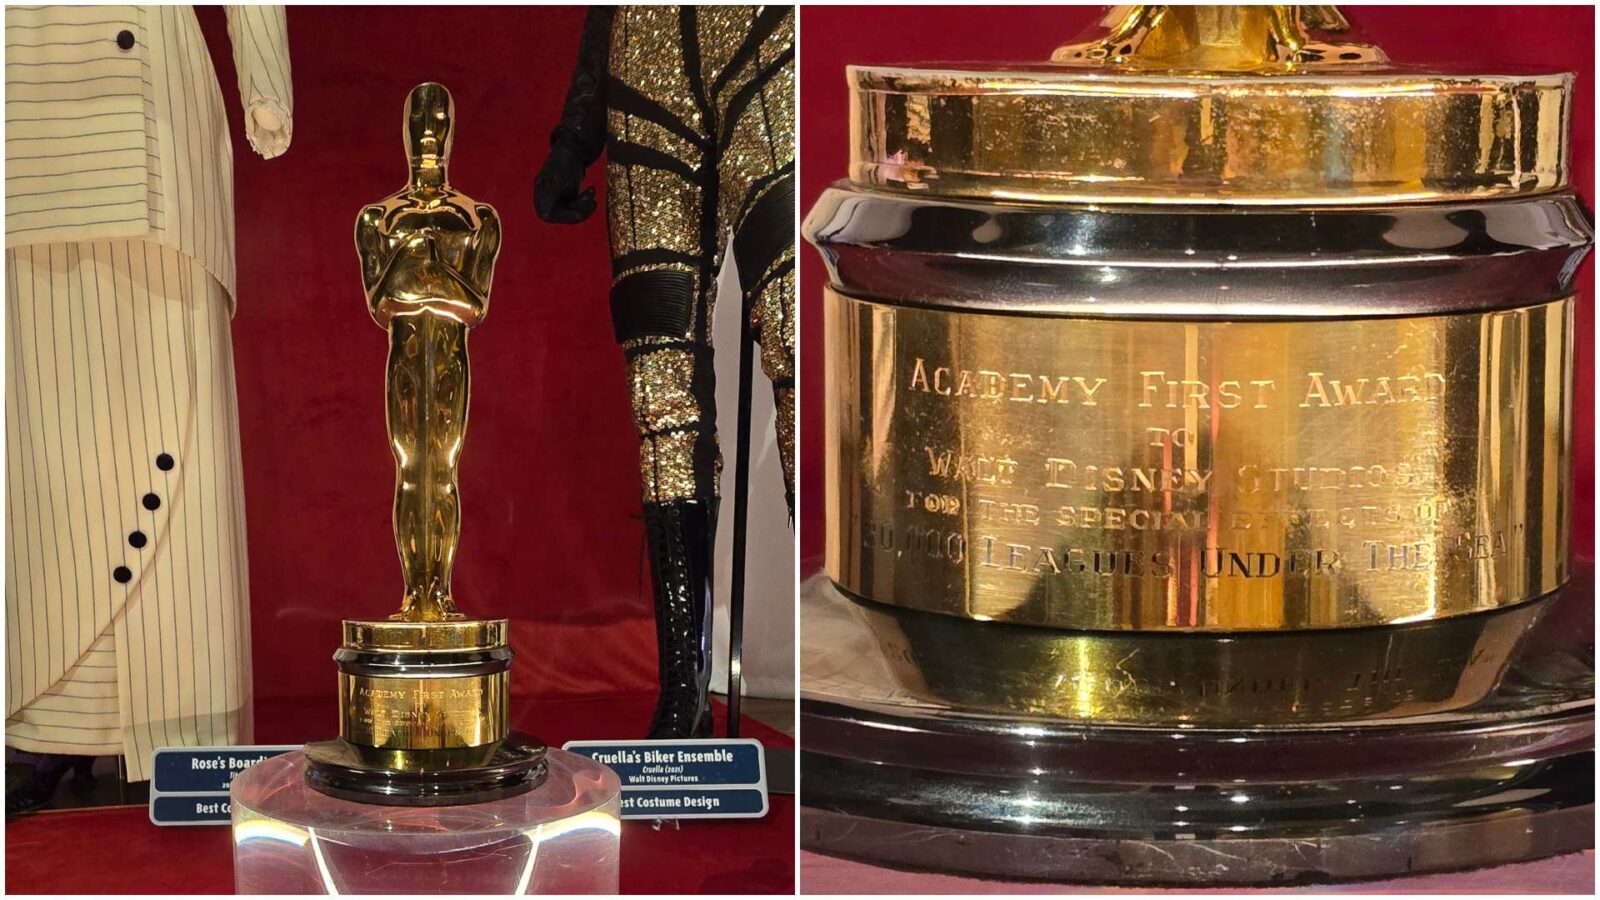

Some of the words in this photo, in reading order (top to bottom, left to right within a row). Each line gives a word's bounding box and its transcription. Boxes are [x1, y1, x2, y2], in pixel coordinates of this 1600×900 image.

[908, 357, 1107, 406] ACADEMY
[1138, 370, 1276, 409] FIRST
[1299, 371, 1446, 408] AWARD
[1146, 427, 1196, 447] TO
[1045, 457, 1213, 493] DISNEY
[978, 499, 1041, 526] THE
[977, 534, 1181, 579] LEAGUES
[1362, 538, 1436, 573] THE
[191, 756, 226, 770] Rose's
[229, 755, 268, 769] Boar
[592, 750, 641, 764] Cruella's
[644, 750, 674, 763] Biker
[677, 749, 733, 763] Ensemble
[642, 765, 664, 774] Cruella
[629, 775, 646, 783] Walt
[647, 775, 669, 785] Disney
[670, 774, 699, 783] Pictures
[196, 803, 219, 814] Best
[620, 797, 635, 808] est
[637, 796, 681, 808] Costume
[684, 796, 720, 810] Design
